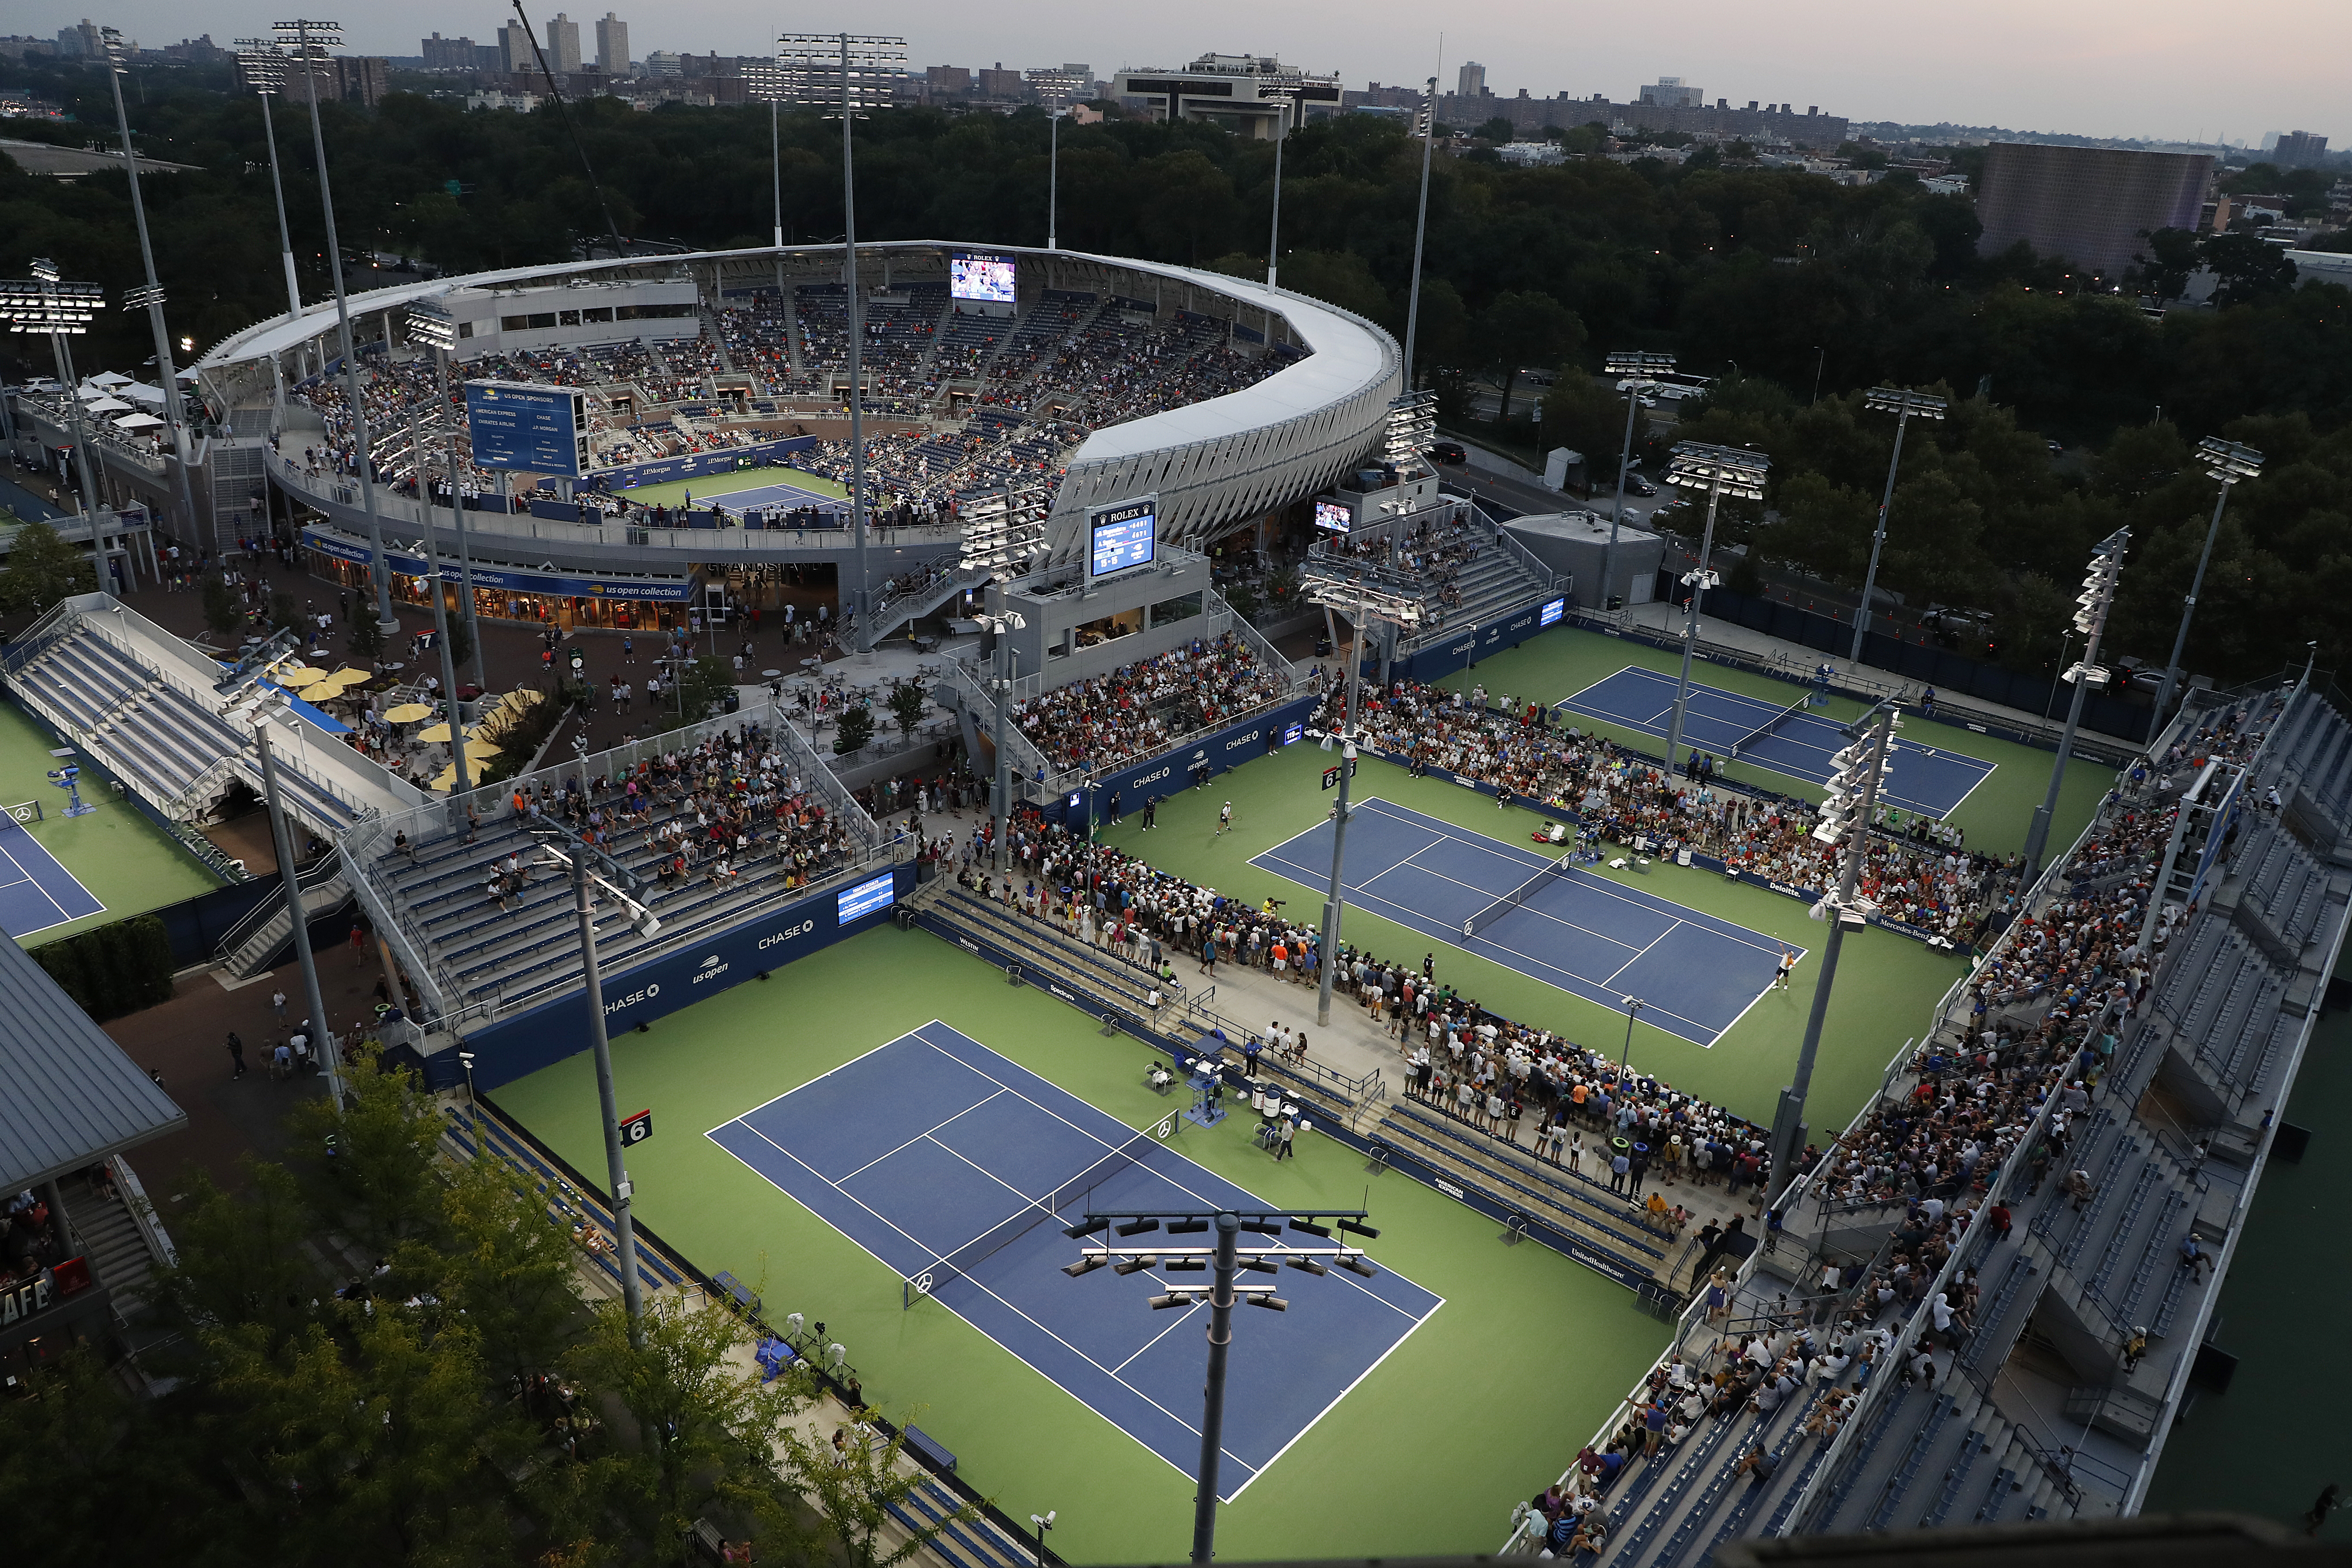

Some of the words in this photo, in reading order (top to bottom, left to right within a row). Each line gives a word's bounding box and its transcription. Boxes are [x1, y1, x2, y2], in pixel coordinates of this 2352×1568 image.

[62, 449, 70, 459] 7
[642, 466, 671, 475] J.P.Morgan
[1110, 508, 1139, 522] ROLEX
[328, 544, 340, 554] open
[340, 547, 364, 559] collection
[450, 571, 463, 580] ope
[471, 573, 504, 584] collection
[617, 587, 640, 596] open
[640, 587, 681, 597] collection
[1684, 603, 1689, 613] 5
[1510, 619, 1527, 631] CHASE
[422, 634, 431, 648] 7
[1491, 635, 1500, 643] open
[1452, 642, 1470, 655] CHASE
[1289, 720, 1298, 729] IBM
[1226, 733, 1251, 750] CHASE
[1371, 748, 1386, 758] Airline
[1194, 758, 1209, 769] open
[1133, 770, 1162, 789] CHASE
[1326, 773, 1334, 787] 6
[1453, 775, 1475, 784] AMERICAN
[1456, 779, 1475, 788] EXPRESS
[1770, 882, 1801, 897] Deloitte.
[1880, 919, 1929, 940] Mercedes-Benz
[758, 925, 801, 950] CHASE
[959, 937, 979, 952] WESTIN
[692, 974, 704, 984] us
[704, 962, 729, 980] open
[1050, 984, 1073, 1001] Spectrum
[630, 1121, 646, 1141] 6
[1435, 1178, 1464, 1195] AMERICAN
[1438, 1183, 1464, 1199] EXPRESS
[1571, 1247, 1624, 1279] UnitedHealthcare
[0, 1278, 49, 1326] AFE
